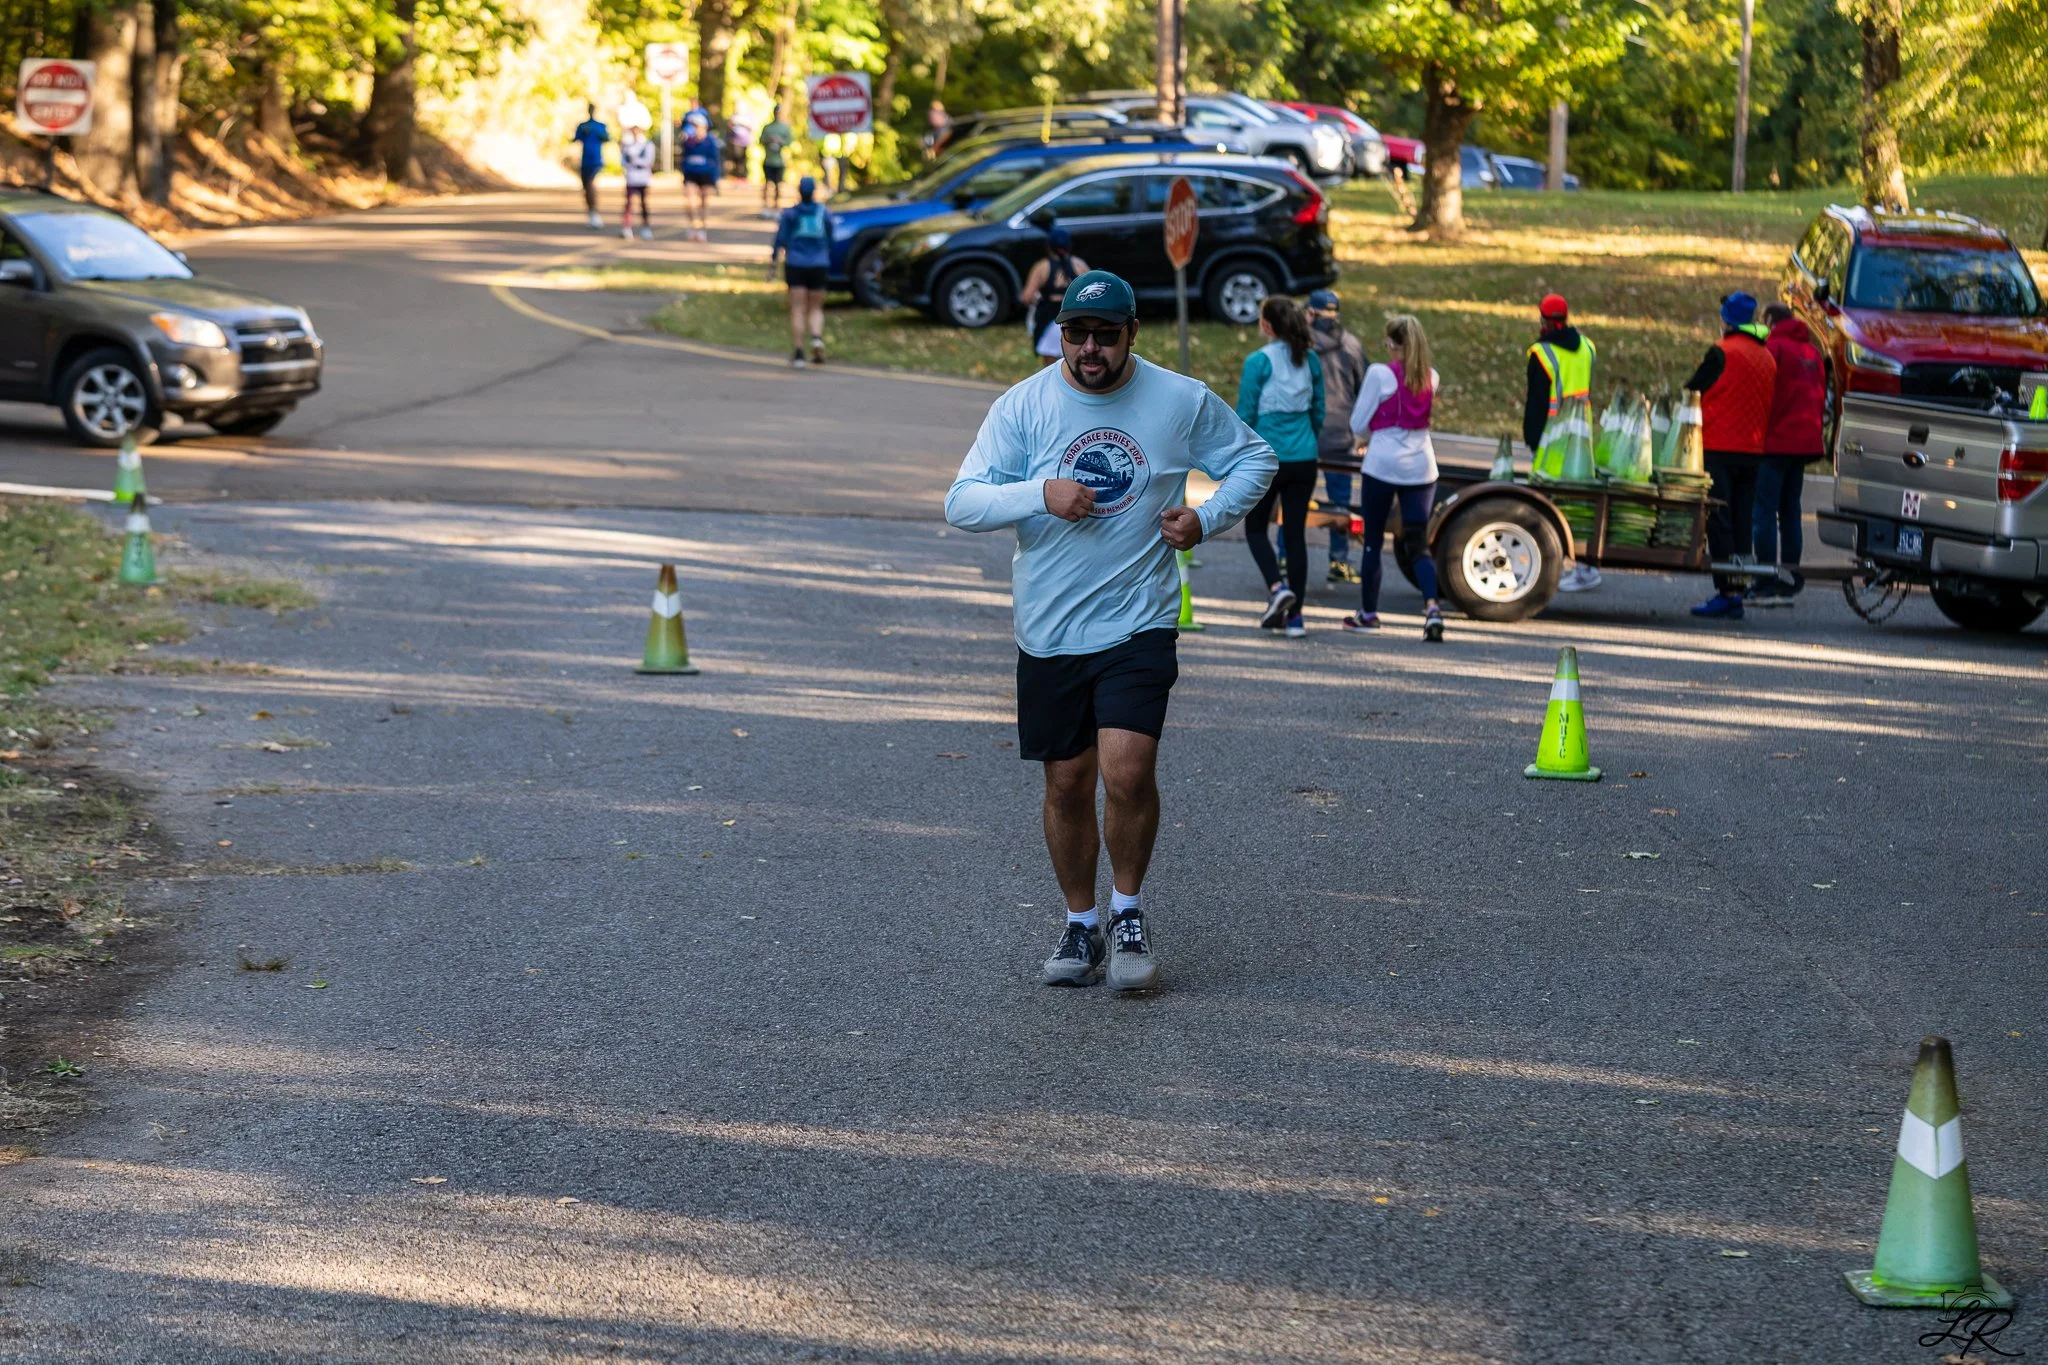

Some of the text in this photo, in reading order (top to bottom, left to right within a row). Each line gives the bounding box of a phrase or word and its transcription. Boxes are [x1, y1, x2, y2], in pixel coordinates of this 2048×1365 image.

[1166, 197, 1196, 244] STOP
[1064, 431, 1145, 466] ROAD RACE SERIES 2026
[1107, 495, 1134, 514] MEMORIAL
